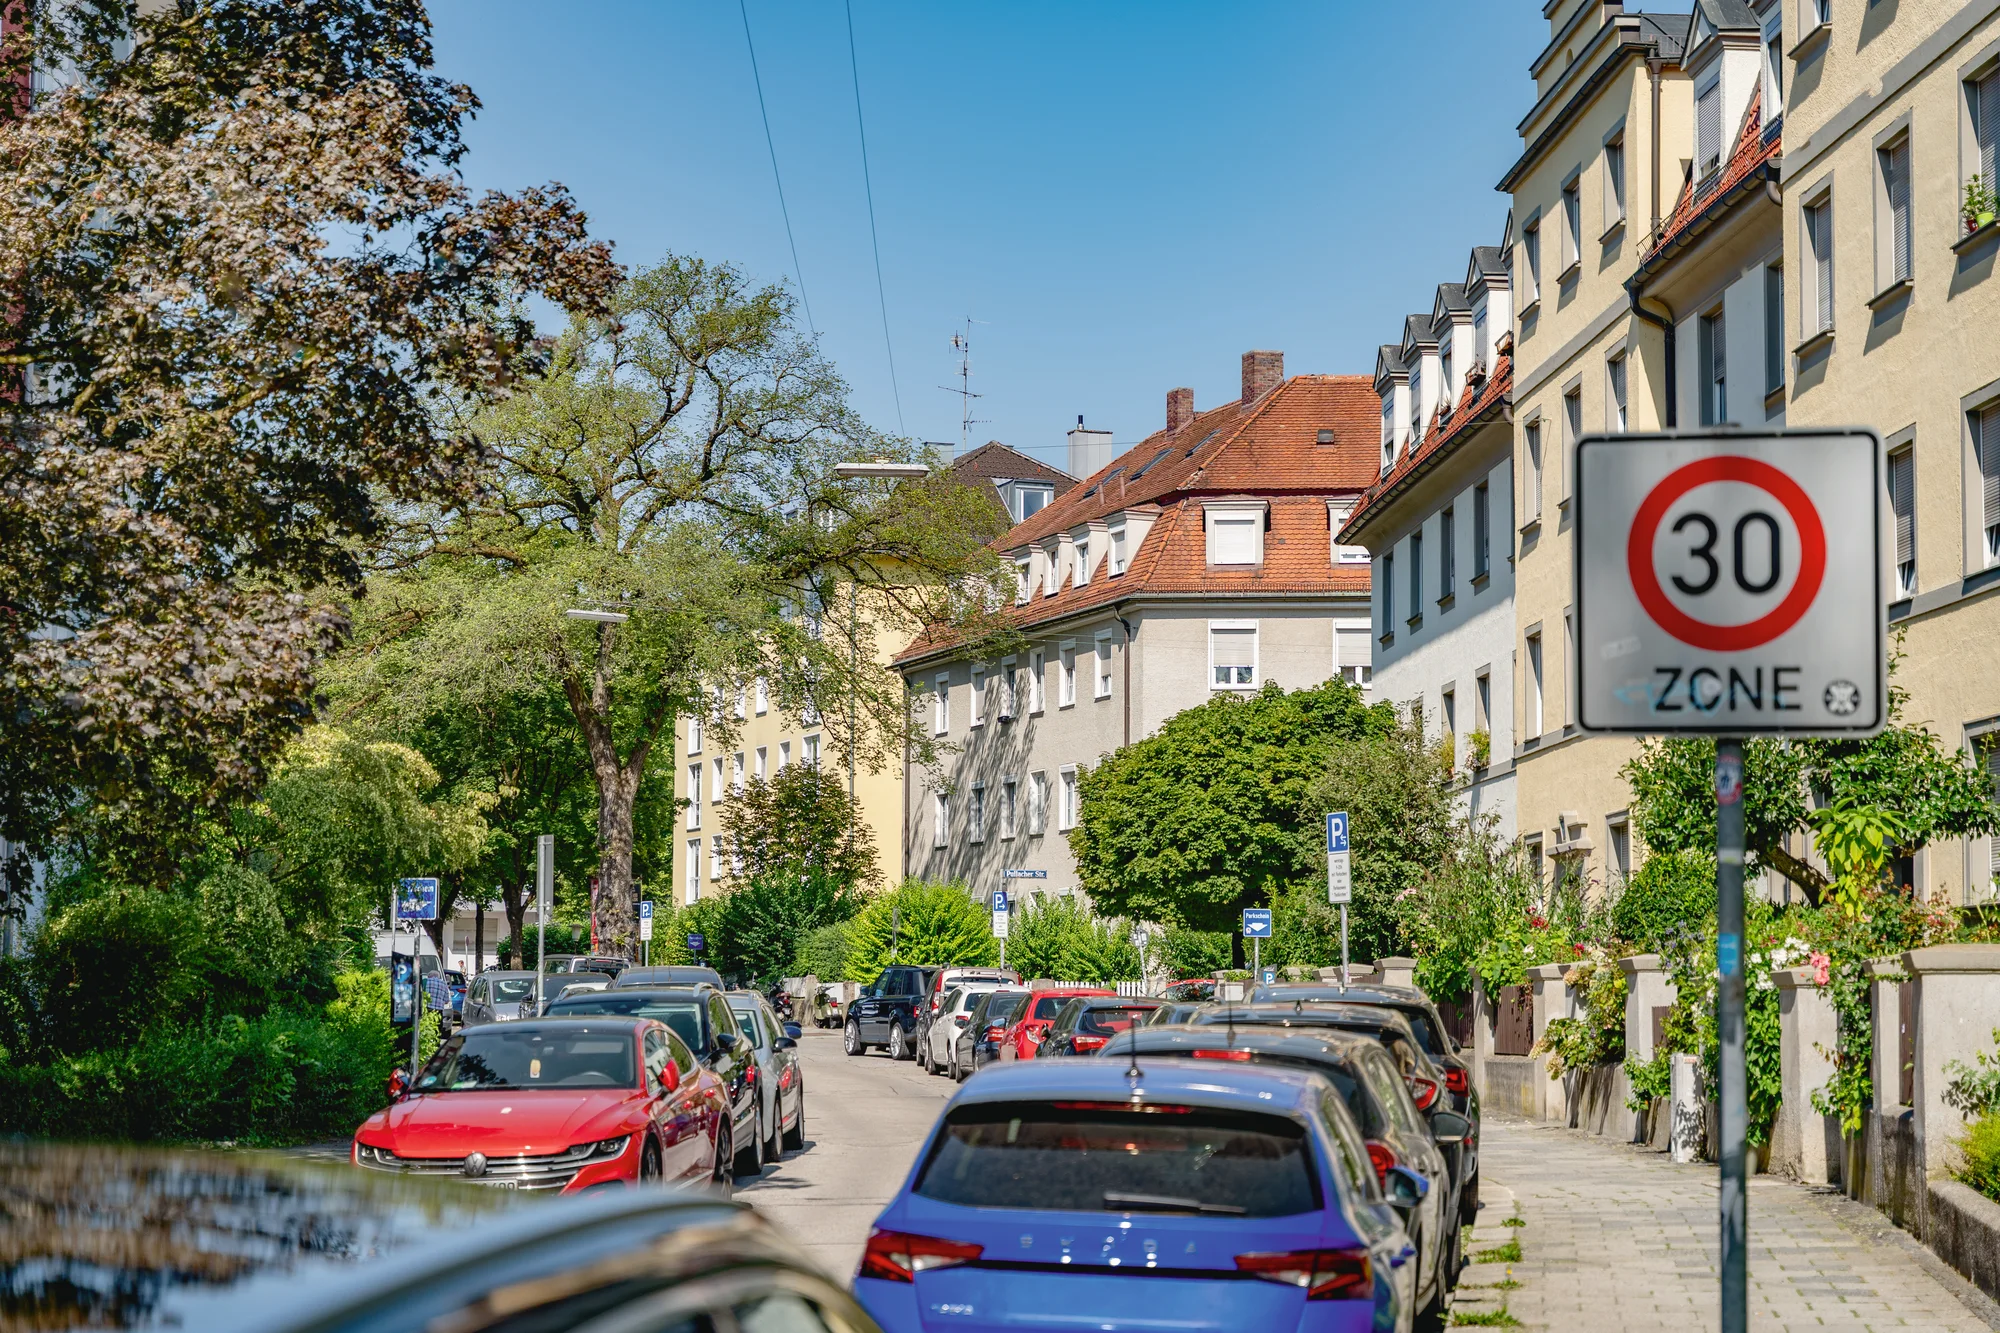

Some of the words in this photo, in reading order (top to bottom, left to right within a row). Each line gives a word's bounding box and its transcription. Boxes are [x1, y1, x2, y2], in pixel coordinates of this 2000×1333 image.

[1671, 511, 1781, 596] 30
[1654, 666, 1803, 712] ZONE
[1331, 817, 1343, 848] P
[1006, 870, 1034, 878] Pullacher
[1035, 870, 1045, 878] Str.
[995, 894, 1004, 910] P
[642, 904, 649, 917] P
[397, 964, 407, 980] P
[1265, 973, 1274, 985] P
